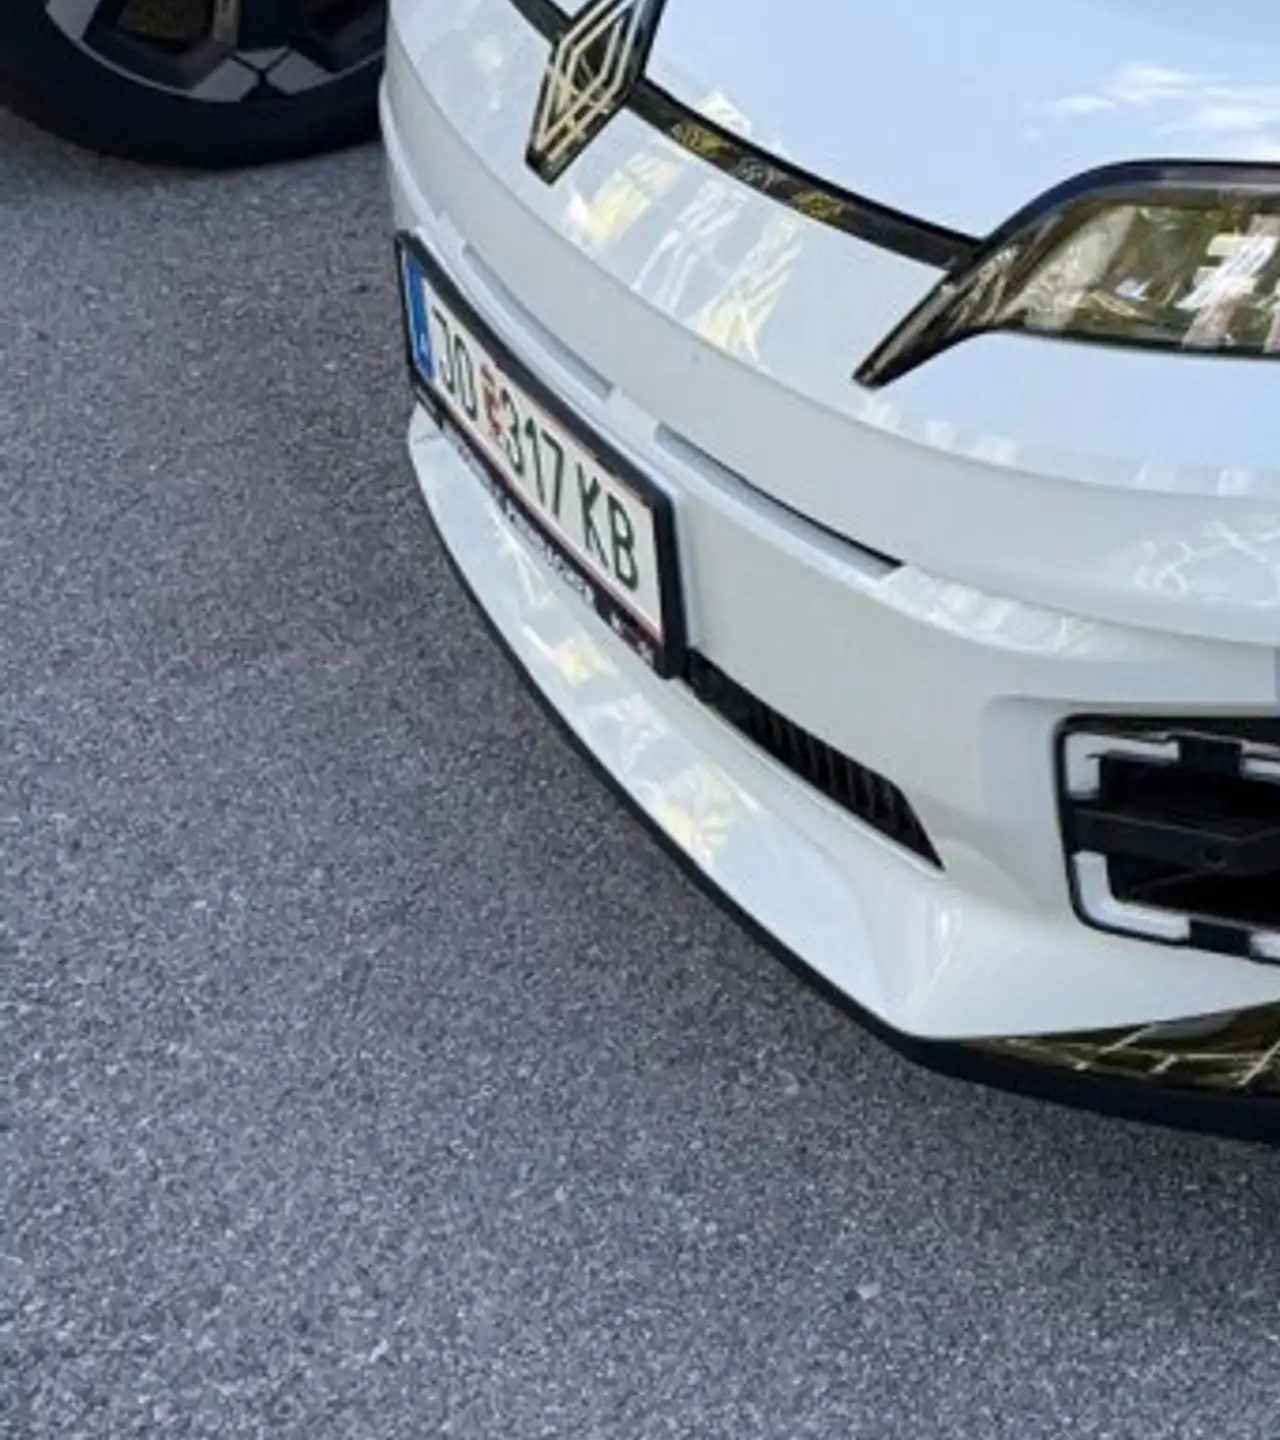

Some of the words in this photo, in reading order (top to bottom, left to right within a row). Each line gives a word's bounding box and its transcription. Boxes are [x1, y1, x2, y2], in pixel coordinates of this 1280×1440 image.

[431, 305, 477, 422] JO
[499, 387, 564, 520] 317
[576, 461, 638, 593] KB
